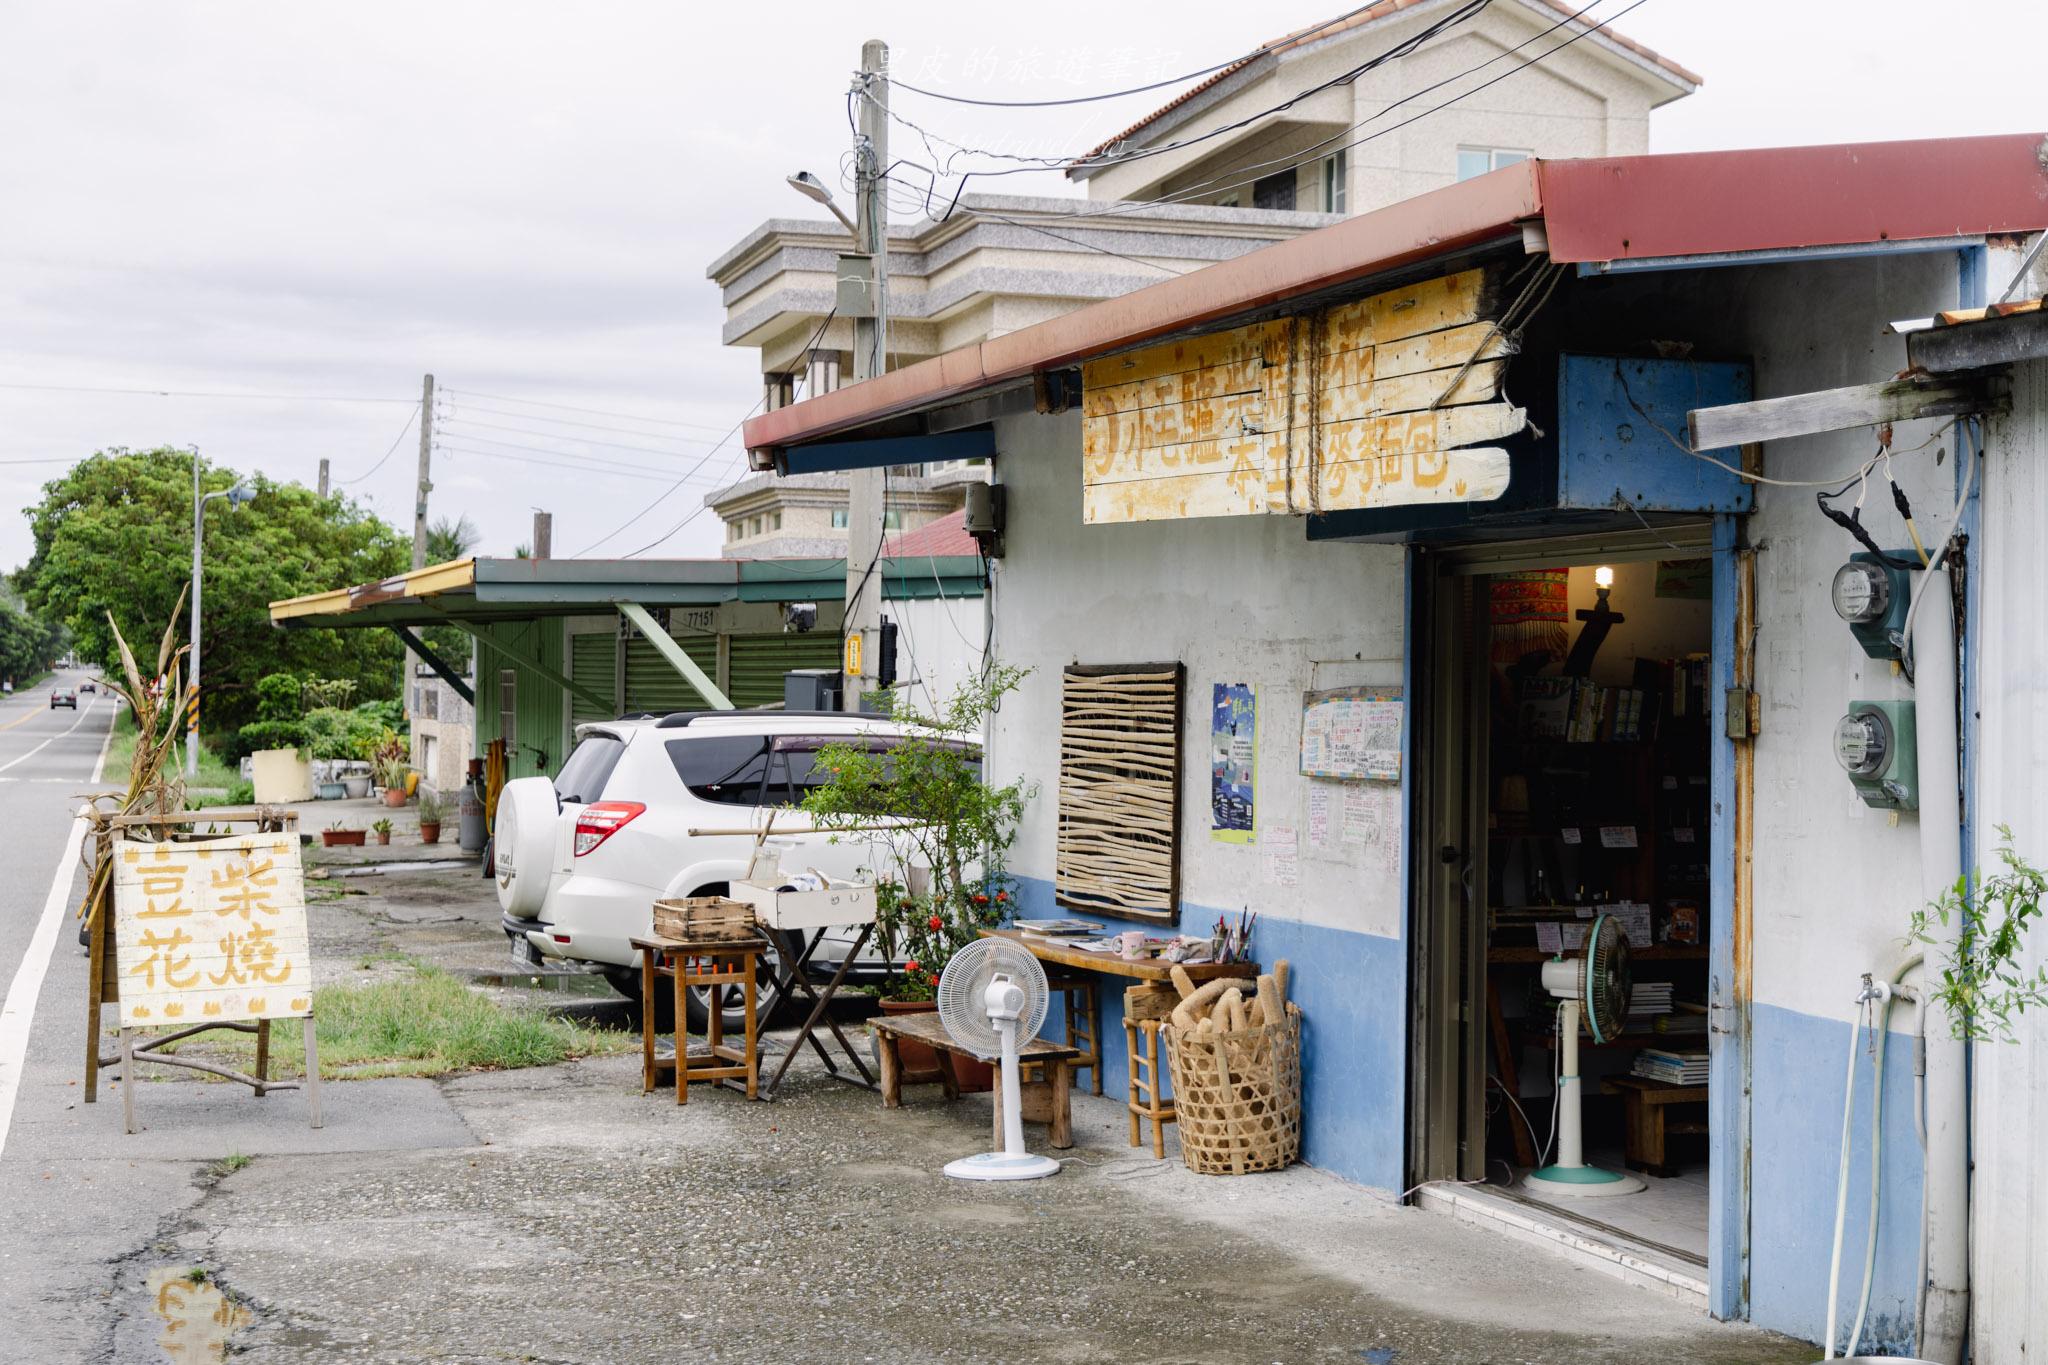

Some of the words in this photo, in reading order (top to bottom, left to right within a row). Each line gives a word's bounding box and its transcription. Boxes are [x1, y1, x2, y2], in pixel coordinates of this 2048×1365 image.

[688, 609, 714, 629] 77151
[129, 865, 201, 989] 豆花
[208, 858, 292, 985] 柴燒
